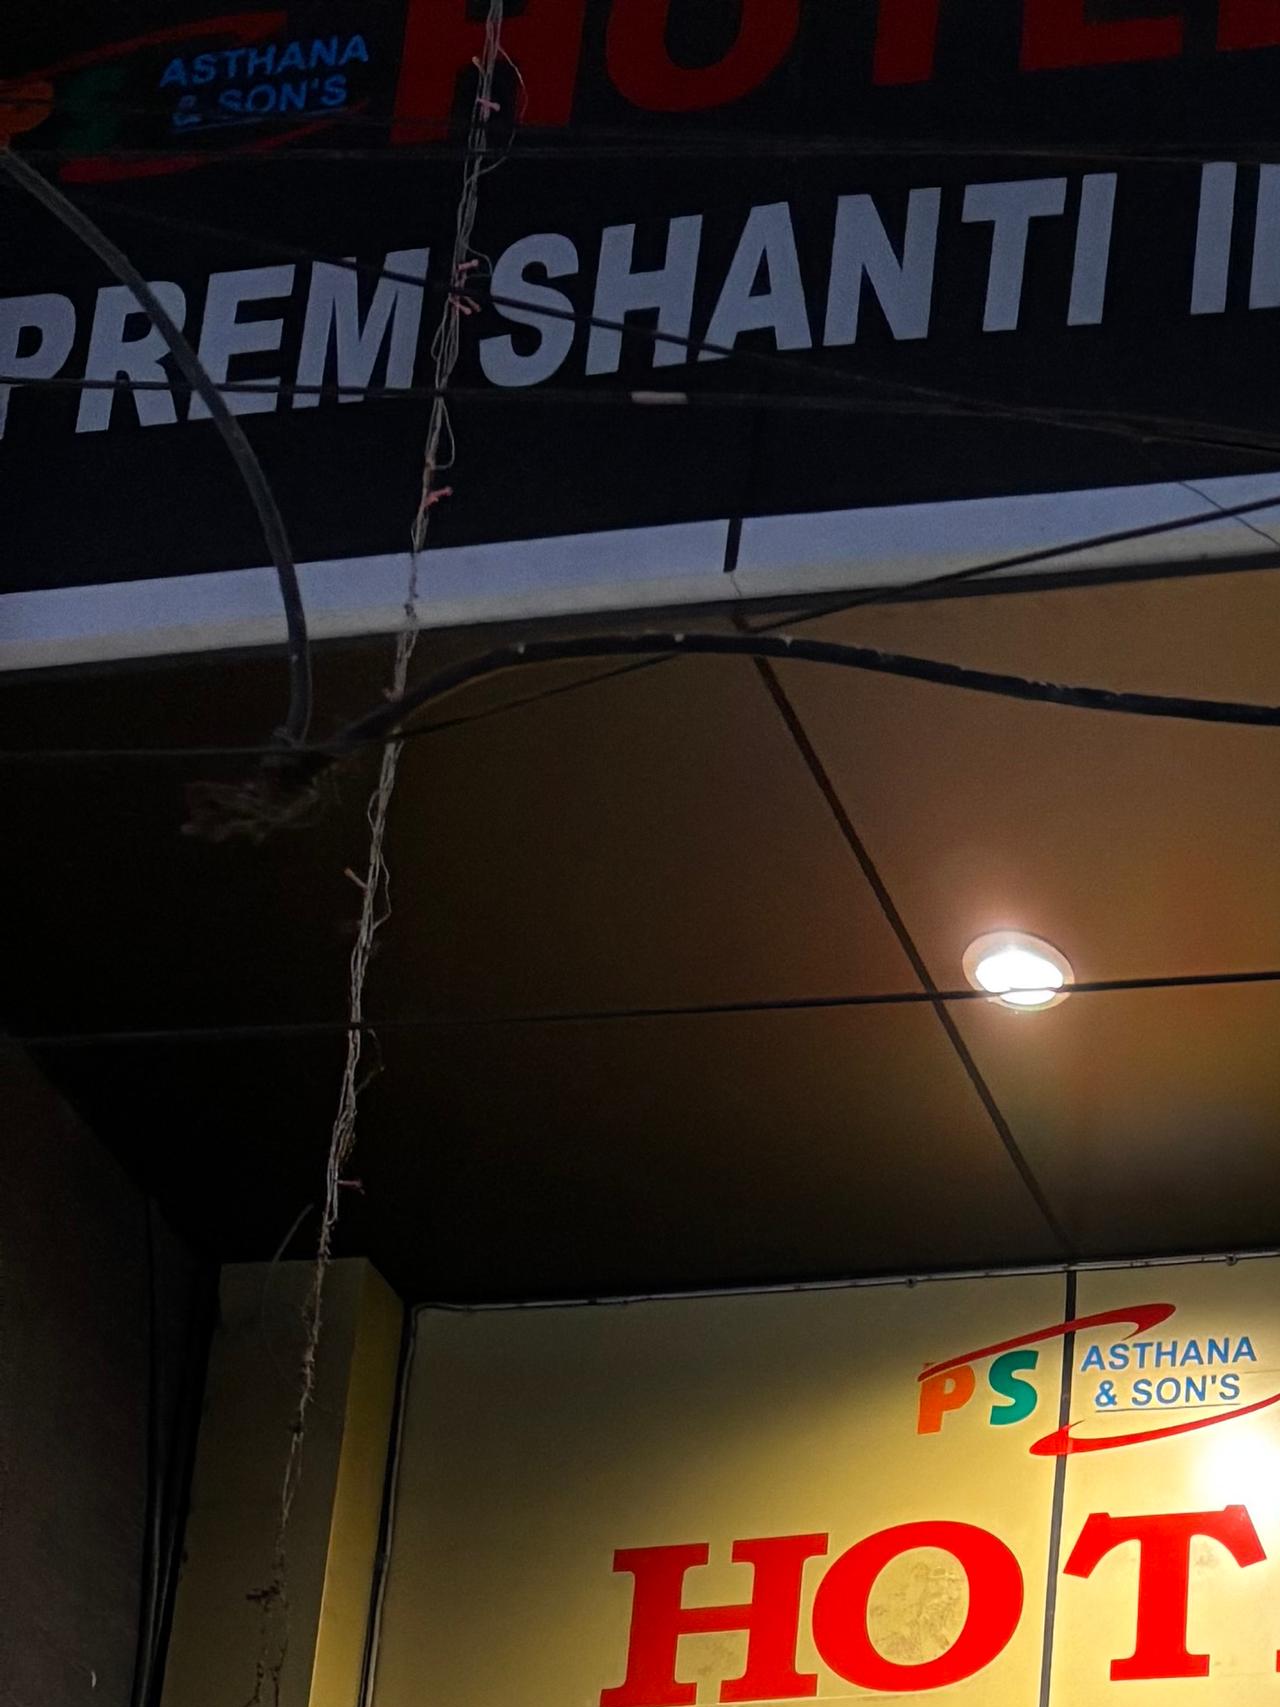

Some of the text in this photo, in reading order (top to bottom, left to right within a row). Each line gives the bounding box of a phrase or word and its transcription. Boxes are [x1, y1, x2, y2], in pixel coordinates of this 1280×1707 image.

[159, 33, 369, 88] ASTHANA
[217, 73, 347, 116] SON'S
[0, 248, 430, 439] PREM
[478, 173, 1117, 387] SHANTI
[1080, 1335, 1257, 1372] ASTHANA
[1096, 1373, 1241, 1407] & SON'S
